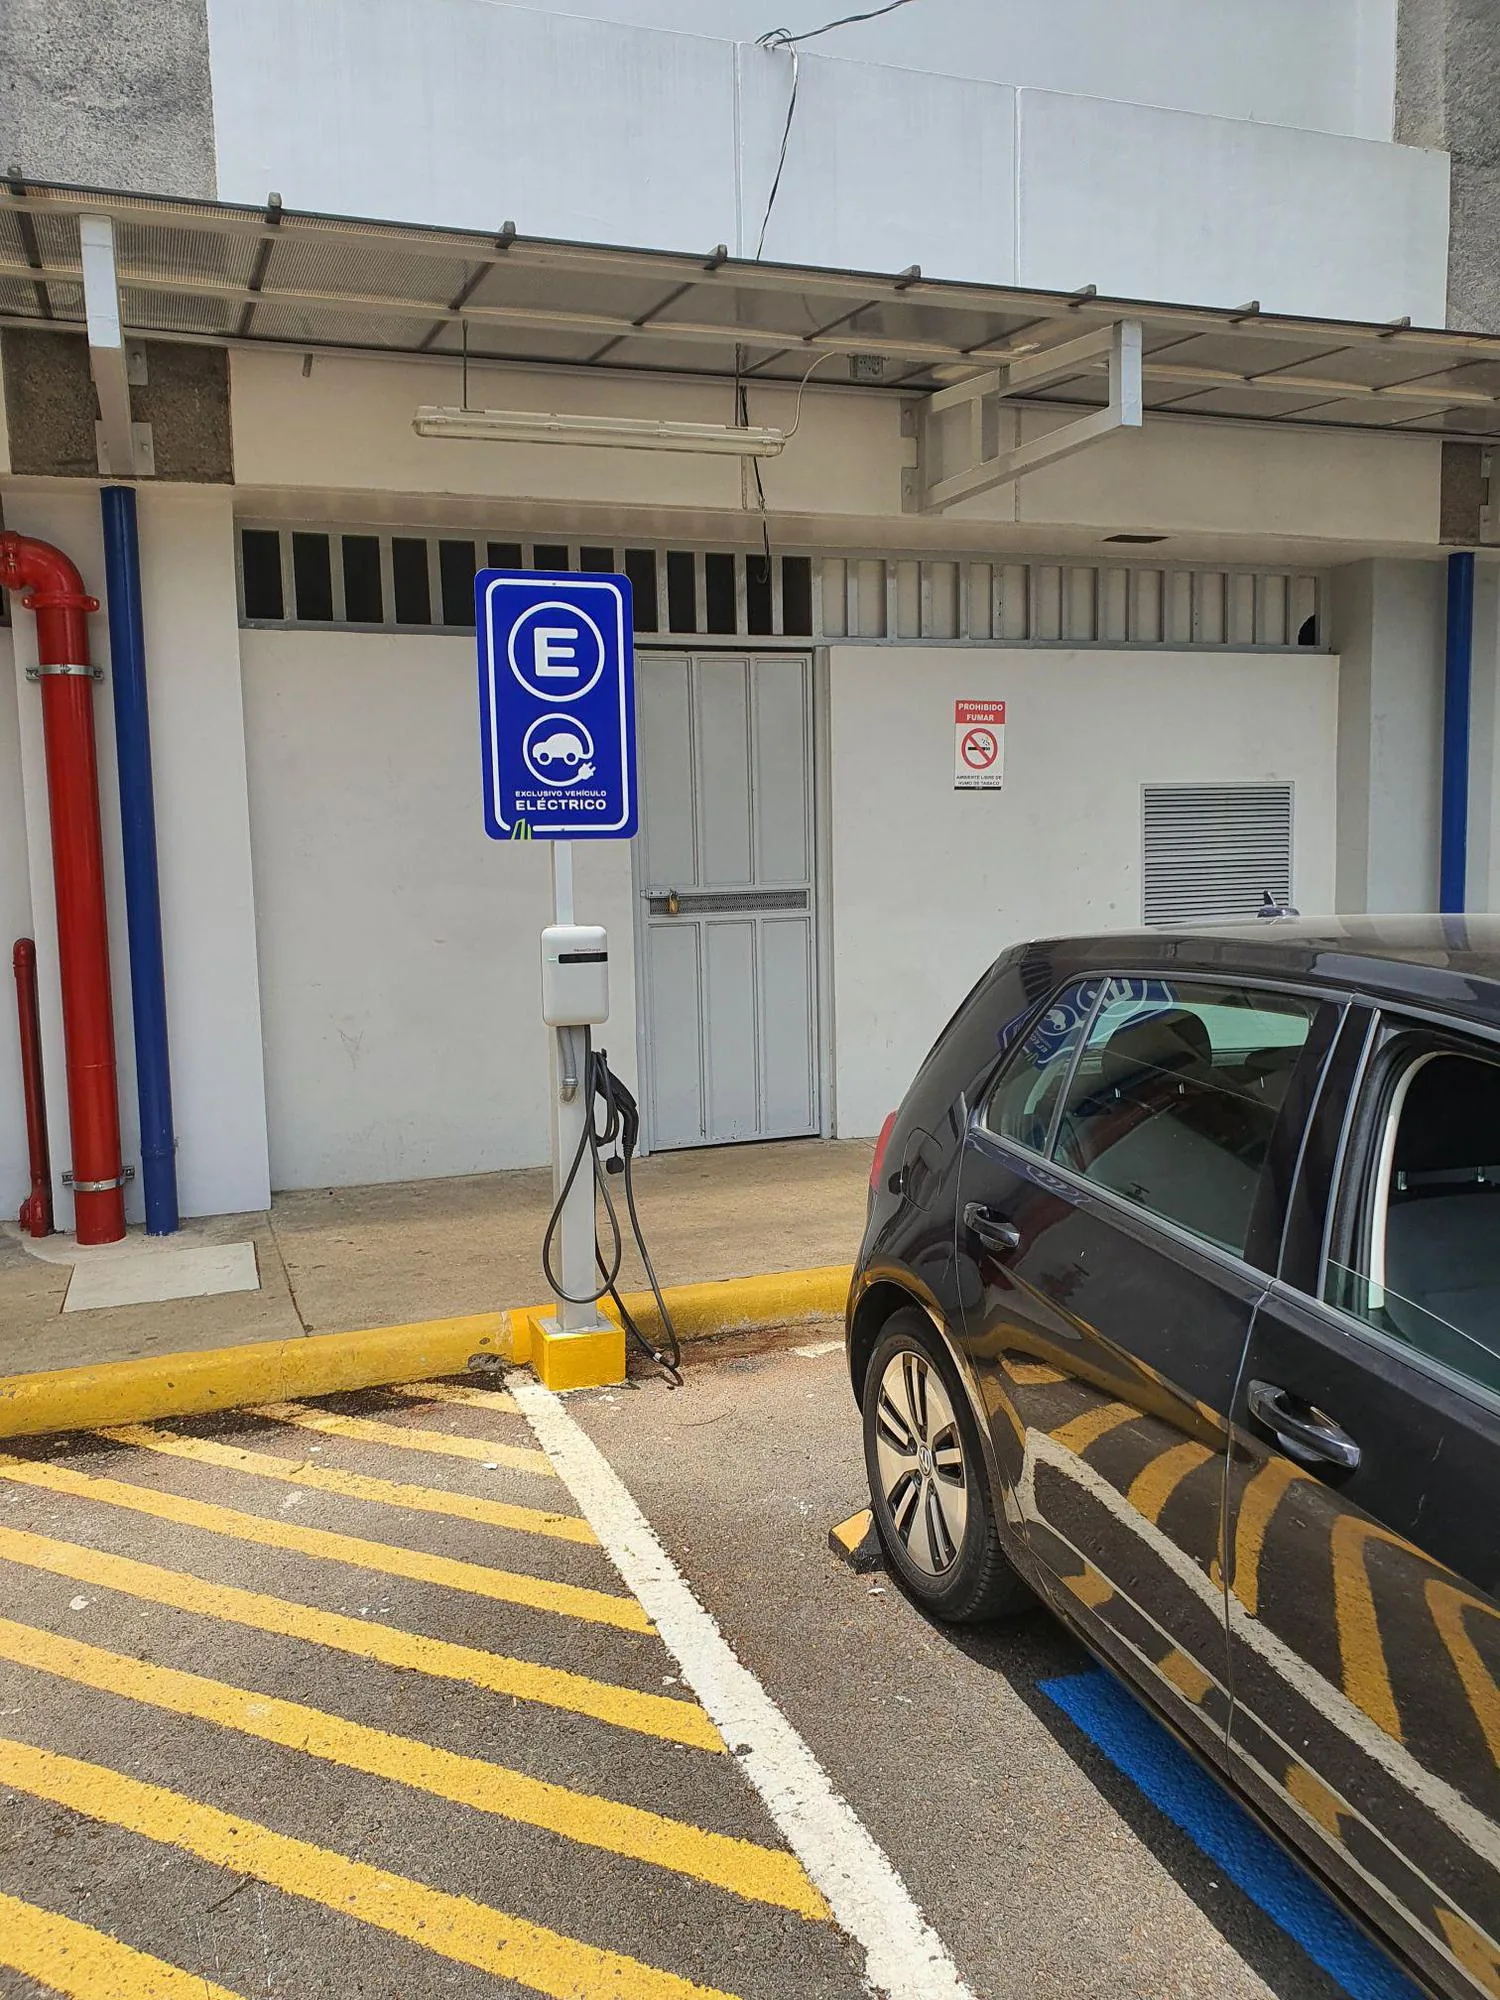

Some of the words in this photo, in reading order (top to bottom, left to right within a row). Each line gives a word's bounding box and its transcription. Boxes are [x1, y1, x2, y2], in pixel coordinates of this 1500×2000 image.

[533, 627, 580, 678] E
[958, 703, 1003, 711] PROHIBIDO
[966, 714, 995, 722] FUMAR
[515, 790, 563, 798] EXCLUSIVO
[564, 789, 607, 798] VEHÍCULO
[515, 797, 607, 811] ELÉCTRICO
